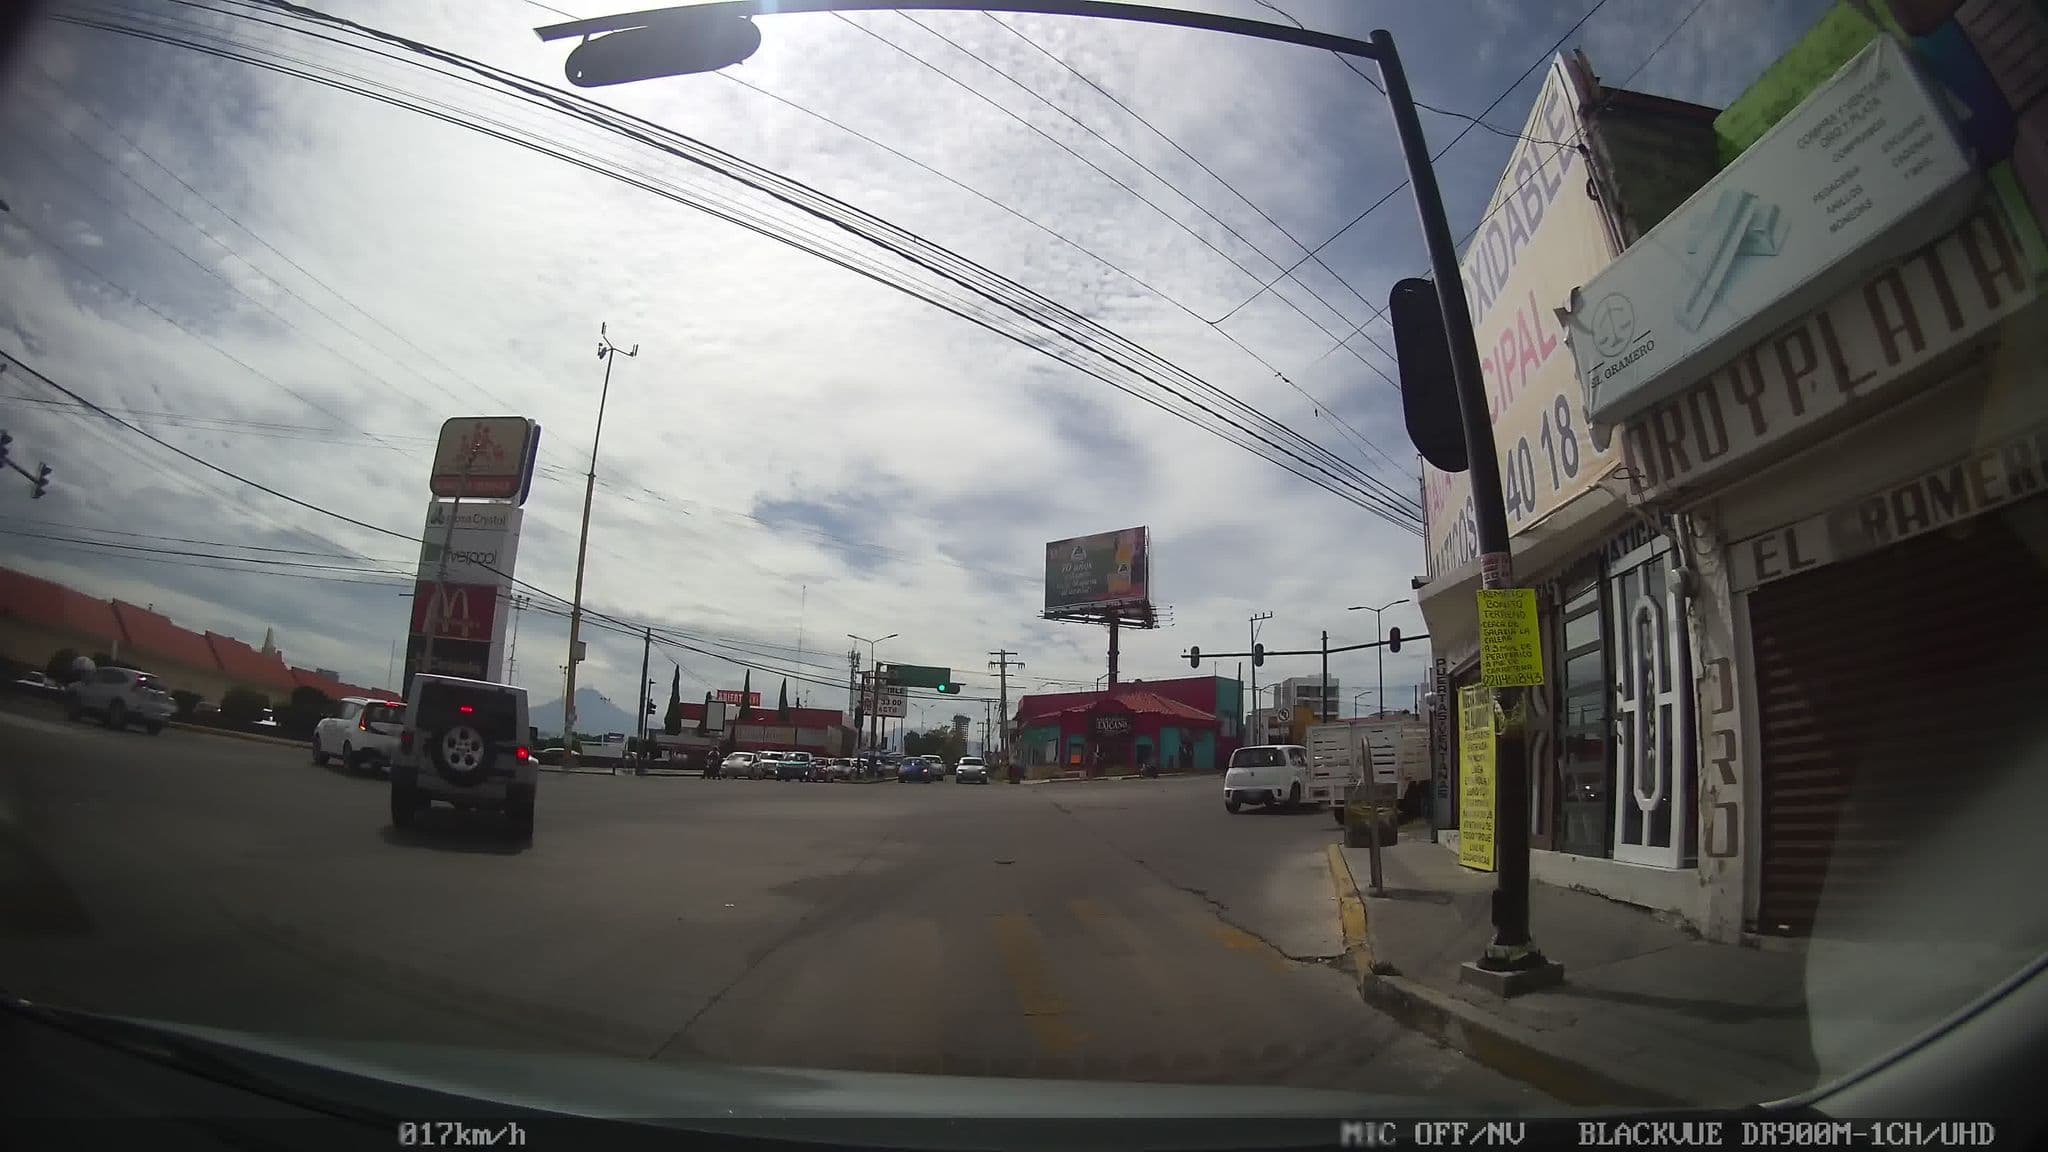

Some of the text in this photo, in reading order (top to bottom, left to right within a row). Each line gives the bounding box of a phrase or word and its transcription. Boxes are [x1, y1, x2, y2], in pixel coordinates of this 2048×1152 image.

[1603, 339, 1656, 382] GRAMERO
[1730, 344, 1768, 437] Y
[1773, 201, 2028, 416] PLATA
[1507, 436, 1536, 521] 40
[1540, 394, 1579, 491] 18
[1752, 526, 1817, 582] EL
